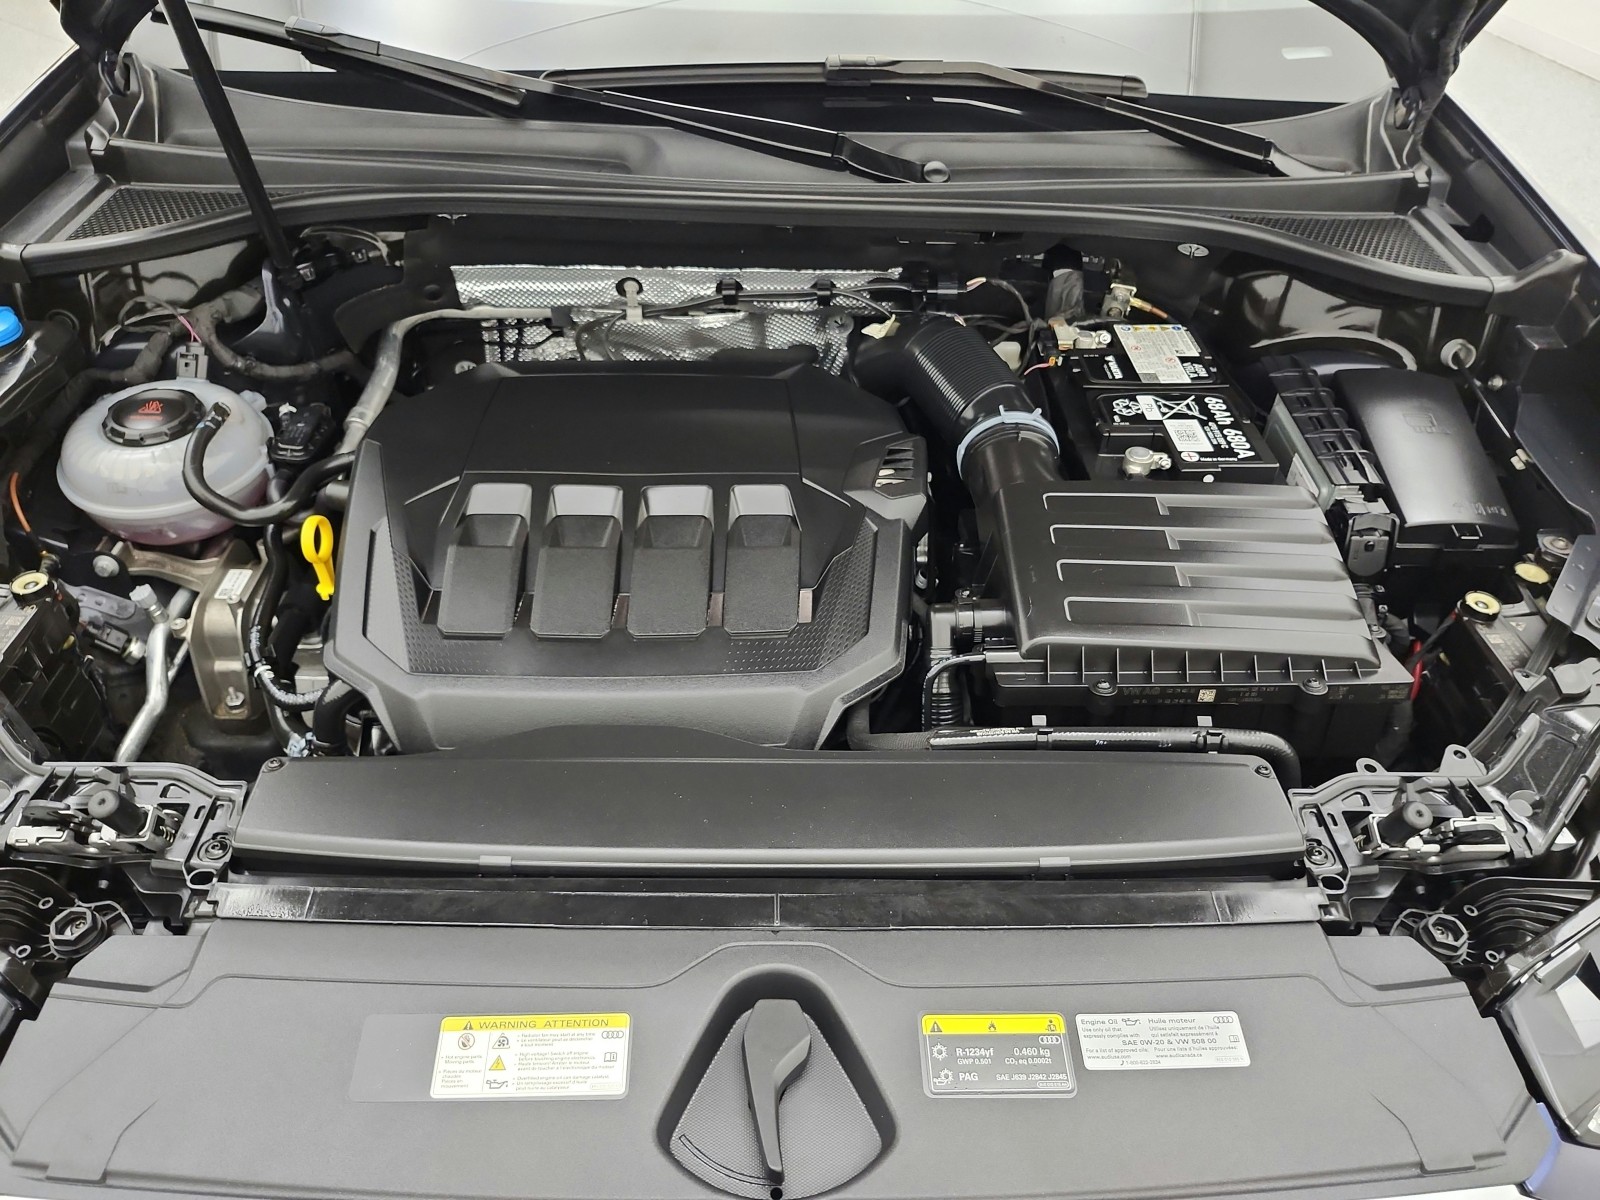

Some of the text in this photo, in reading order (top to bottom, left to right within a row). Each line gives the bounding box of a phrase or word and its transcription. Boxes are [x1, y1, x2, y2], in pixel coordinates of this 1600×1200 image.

[1146, 403, 1154, 412] Pb
[1204, 396, 1235, 425] 68Ah
[1222, 428, 1255, 459] 680A
[478, 1019, 609, 1029] WARNING ATTENTION
[1080, 1018, 1106, 1026] Engine
[955, 1047, 1051, 1057] R-1234yf 0.460 kg
[958, 1072, 979, 1081] PAG
[995, 1073, 1010, 1081] SAE
[1048, 1073, 1068, 1081] J2845
